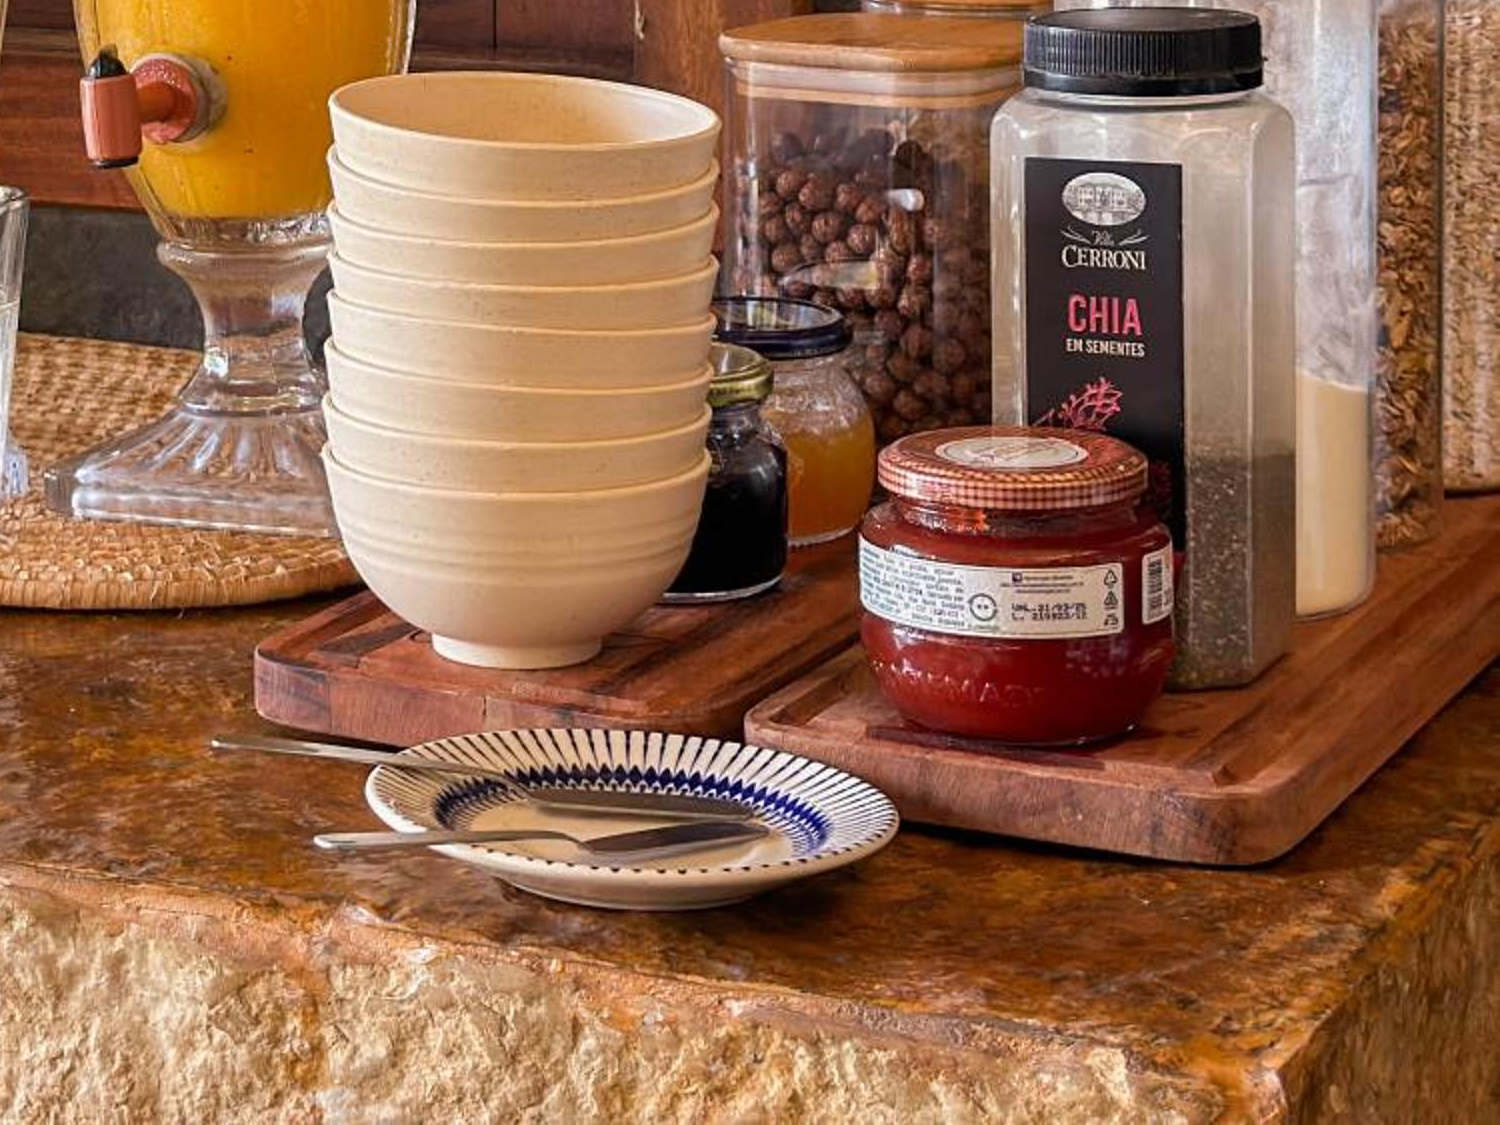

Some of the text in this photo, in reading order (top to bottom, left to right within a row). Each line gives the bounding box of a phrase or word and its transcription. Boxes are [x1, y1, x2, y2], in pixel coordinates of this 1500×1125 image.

[1061, 244, 1146, 270] CERRONI
[1067, 293, 1143, 336] CHIA
[1065, 338, 1145, 357] EM SEMENTES
